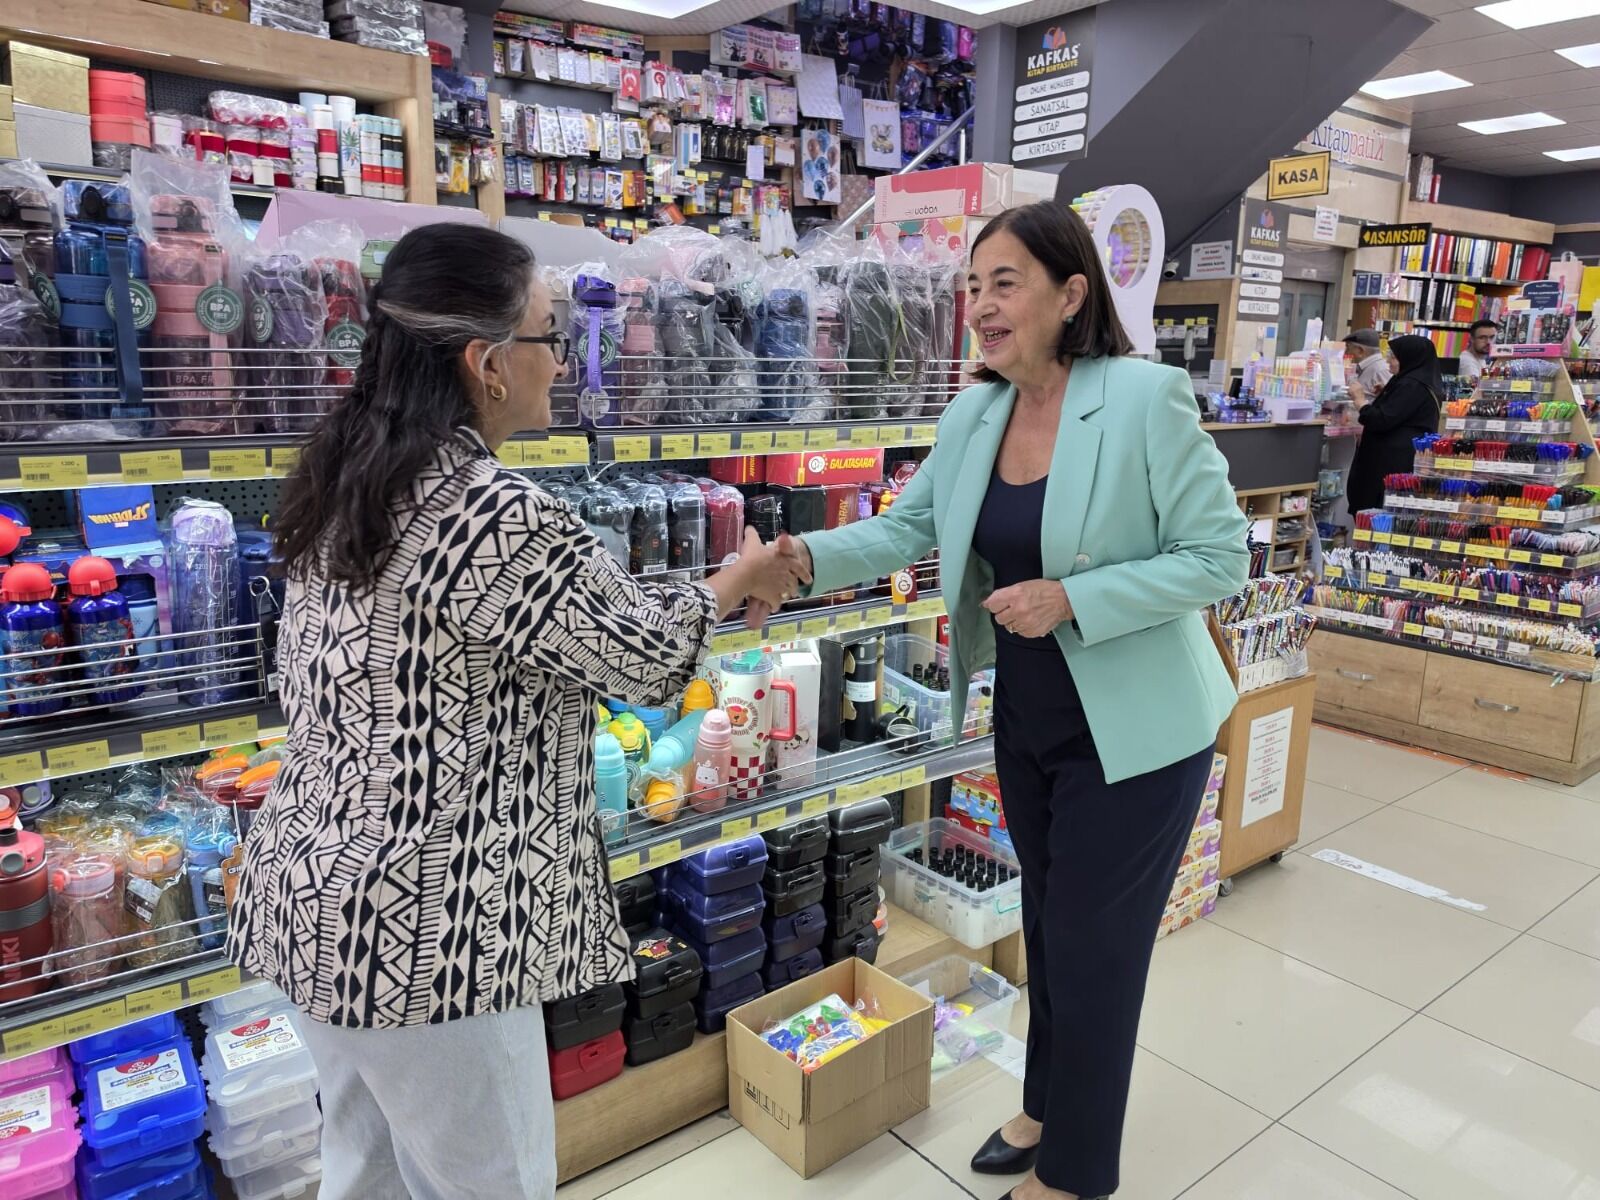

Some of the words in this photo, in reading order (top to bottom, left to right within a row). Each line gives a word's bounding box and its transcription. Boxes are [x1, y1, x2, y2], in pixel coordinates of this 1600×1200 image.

[1027, 45, 1079, 70] KAFKAS
[1030, 98, 1070, 117] SANATSAL
[1278, 168, 1319, 185] KASA
[1251, 227, 1281, 242] KAFKAS
[1370, 225, 1427, 245] ASANSÖR
[210, 303, 231, 313] BPA
[338, 339, 360, 347] BPA
[175, 375, 196, 384] BPA
[830, 457, 877, 470] GALATASARAY
